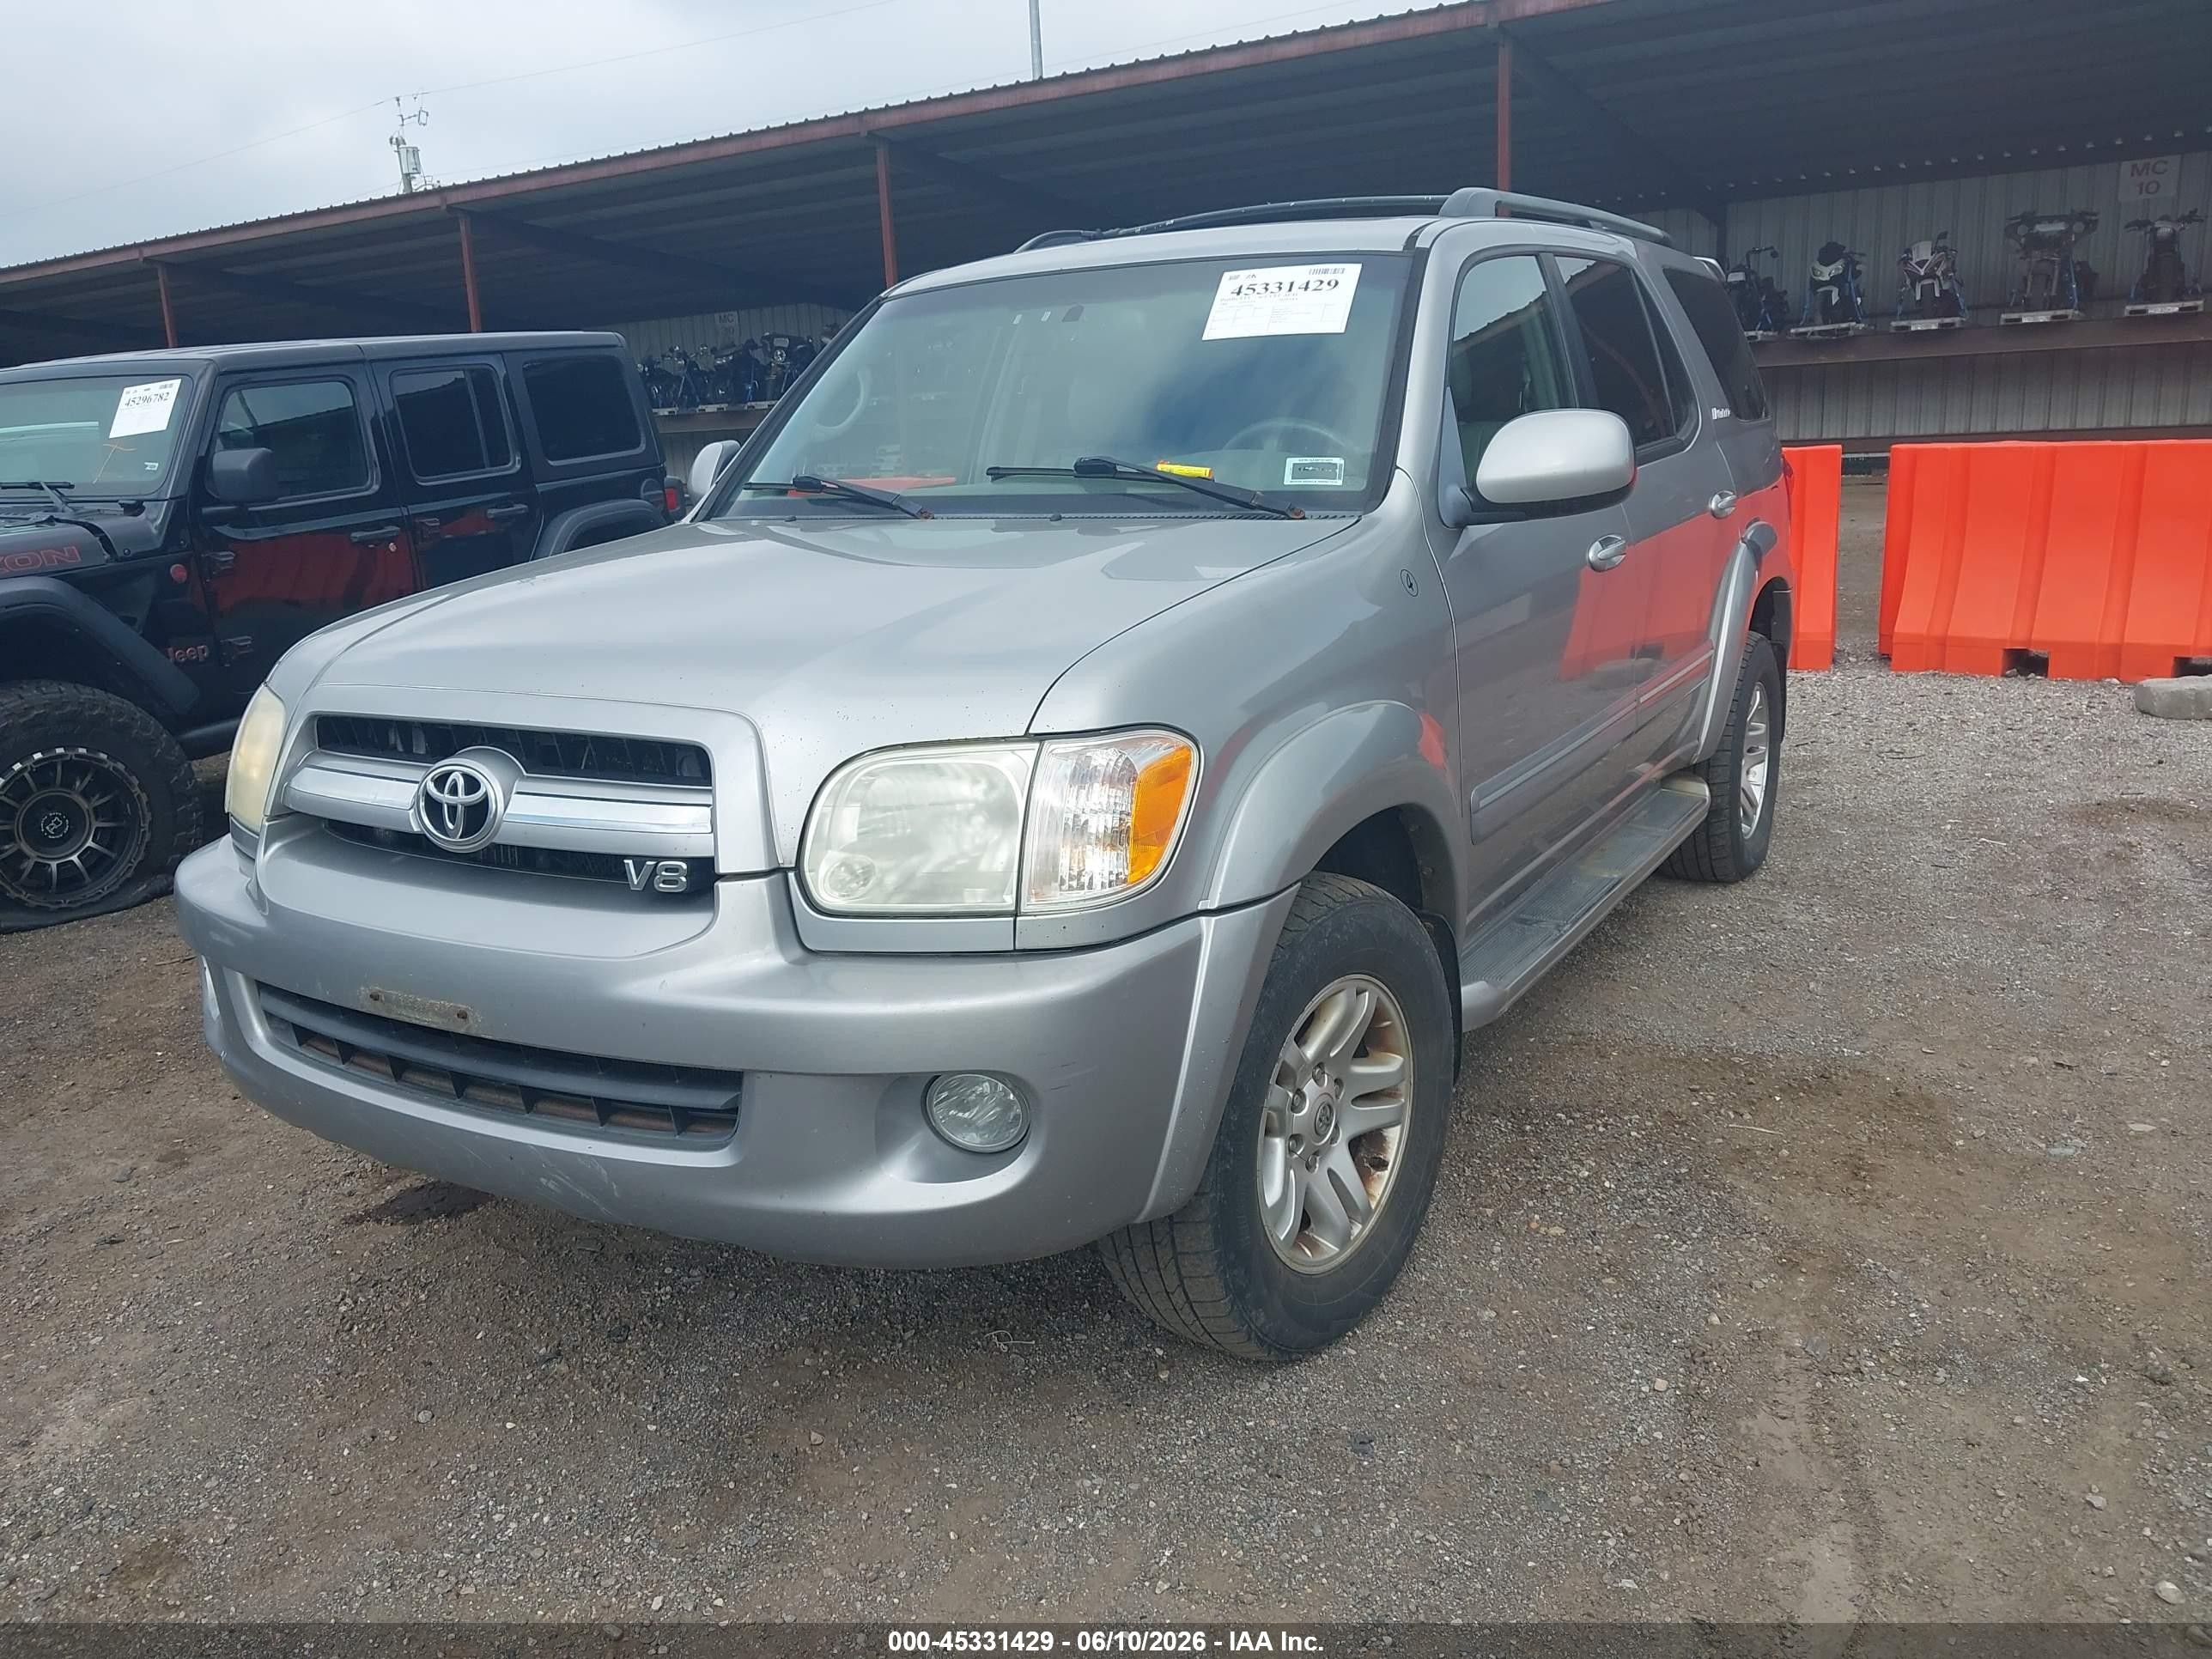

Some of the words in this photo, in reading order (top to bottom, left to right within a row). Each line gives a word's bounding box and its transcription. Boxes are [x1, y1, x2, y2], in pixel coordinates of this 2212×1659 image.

[2130, 160, 2168, 177] MC
[2137, 179, 2161, 196] 10
[1231, 278, 1340, 297] 45331429
[718, 313, 734, 324] MC
[125, 392, 170, 407] 45296782
[0, 545, 82, 573] ON
[623, 859, 688, 893] V8
